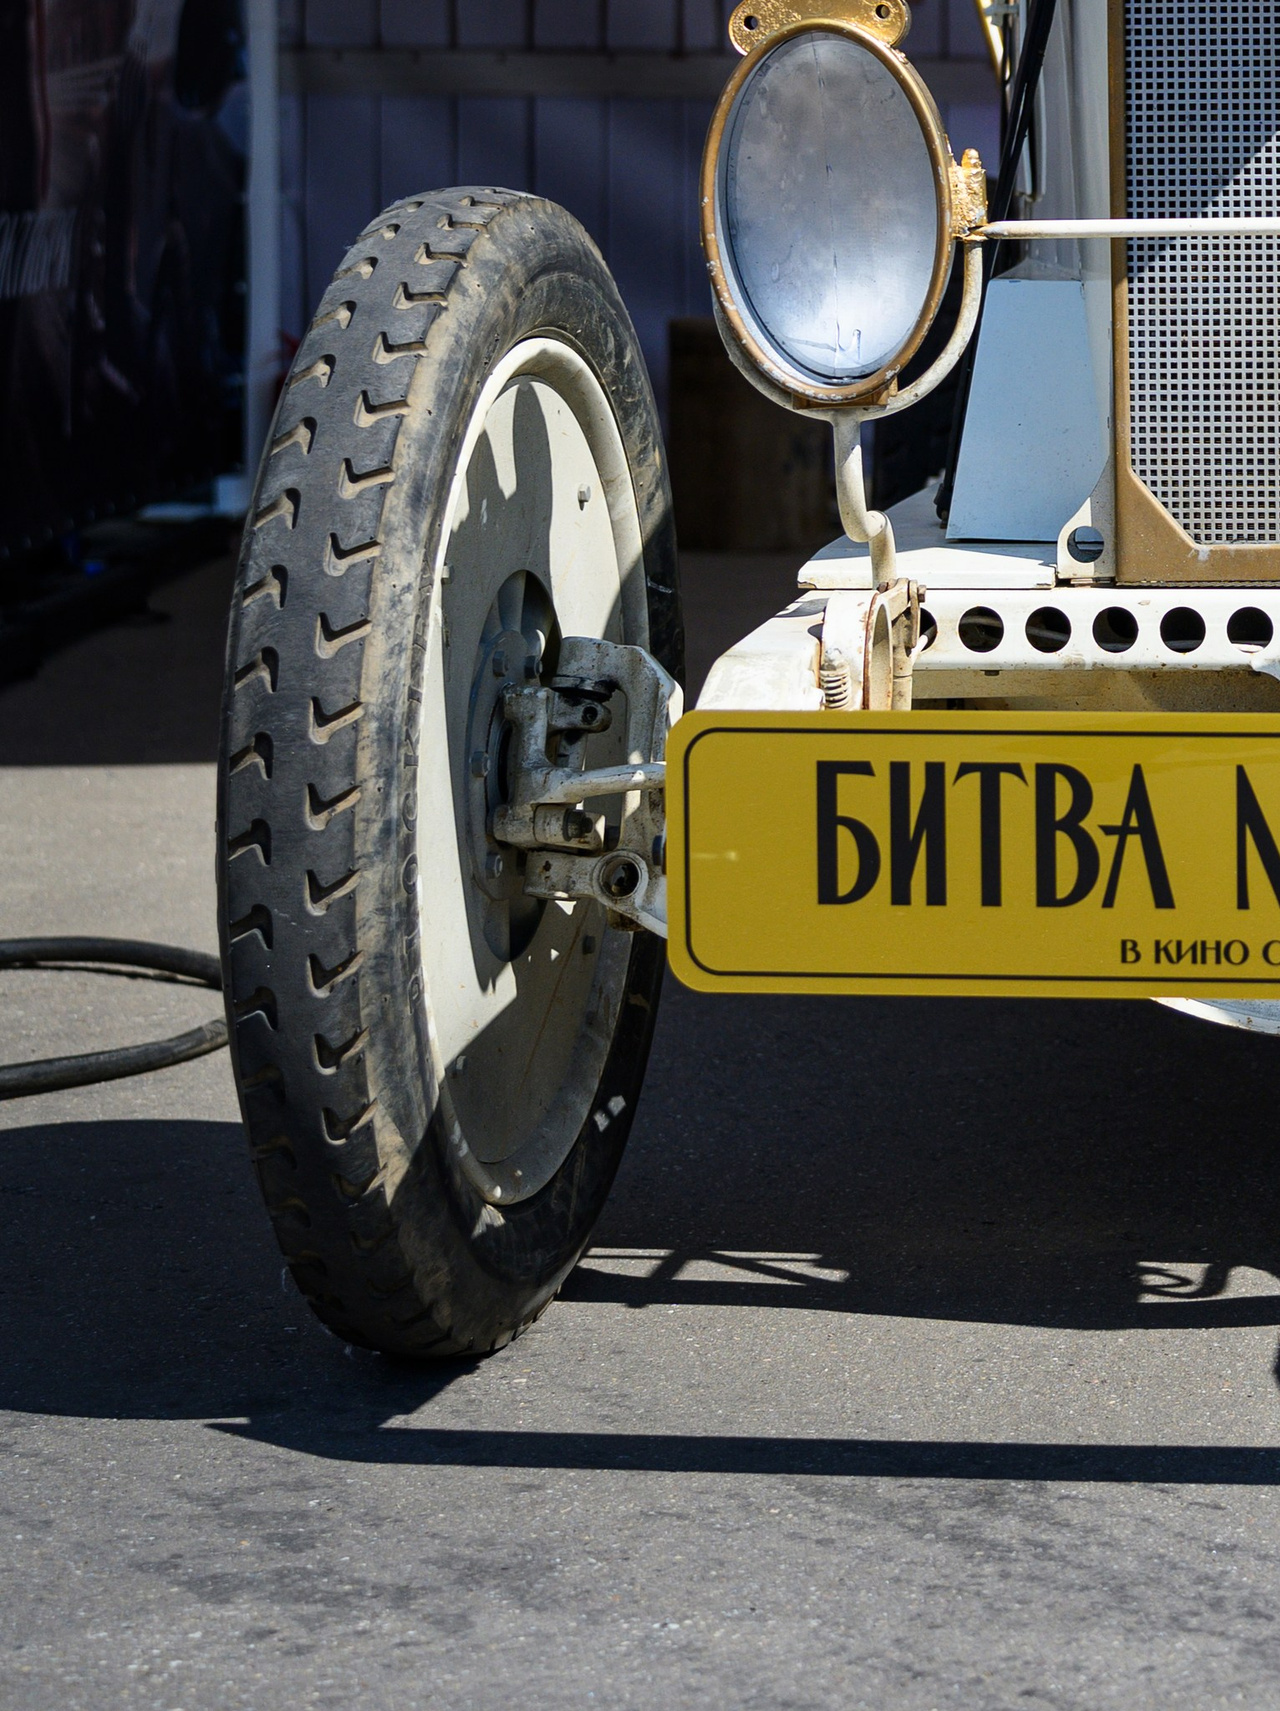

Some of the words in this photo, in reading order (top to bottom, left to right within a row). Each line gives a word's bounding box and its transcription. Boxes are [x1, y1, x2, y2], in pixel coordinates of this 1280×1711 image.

[816, 760, 1176, 909] БИТВА
[1120, 939, 1142, 964] В
[1154, 939, 1250, 966] КИНО
